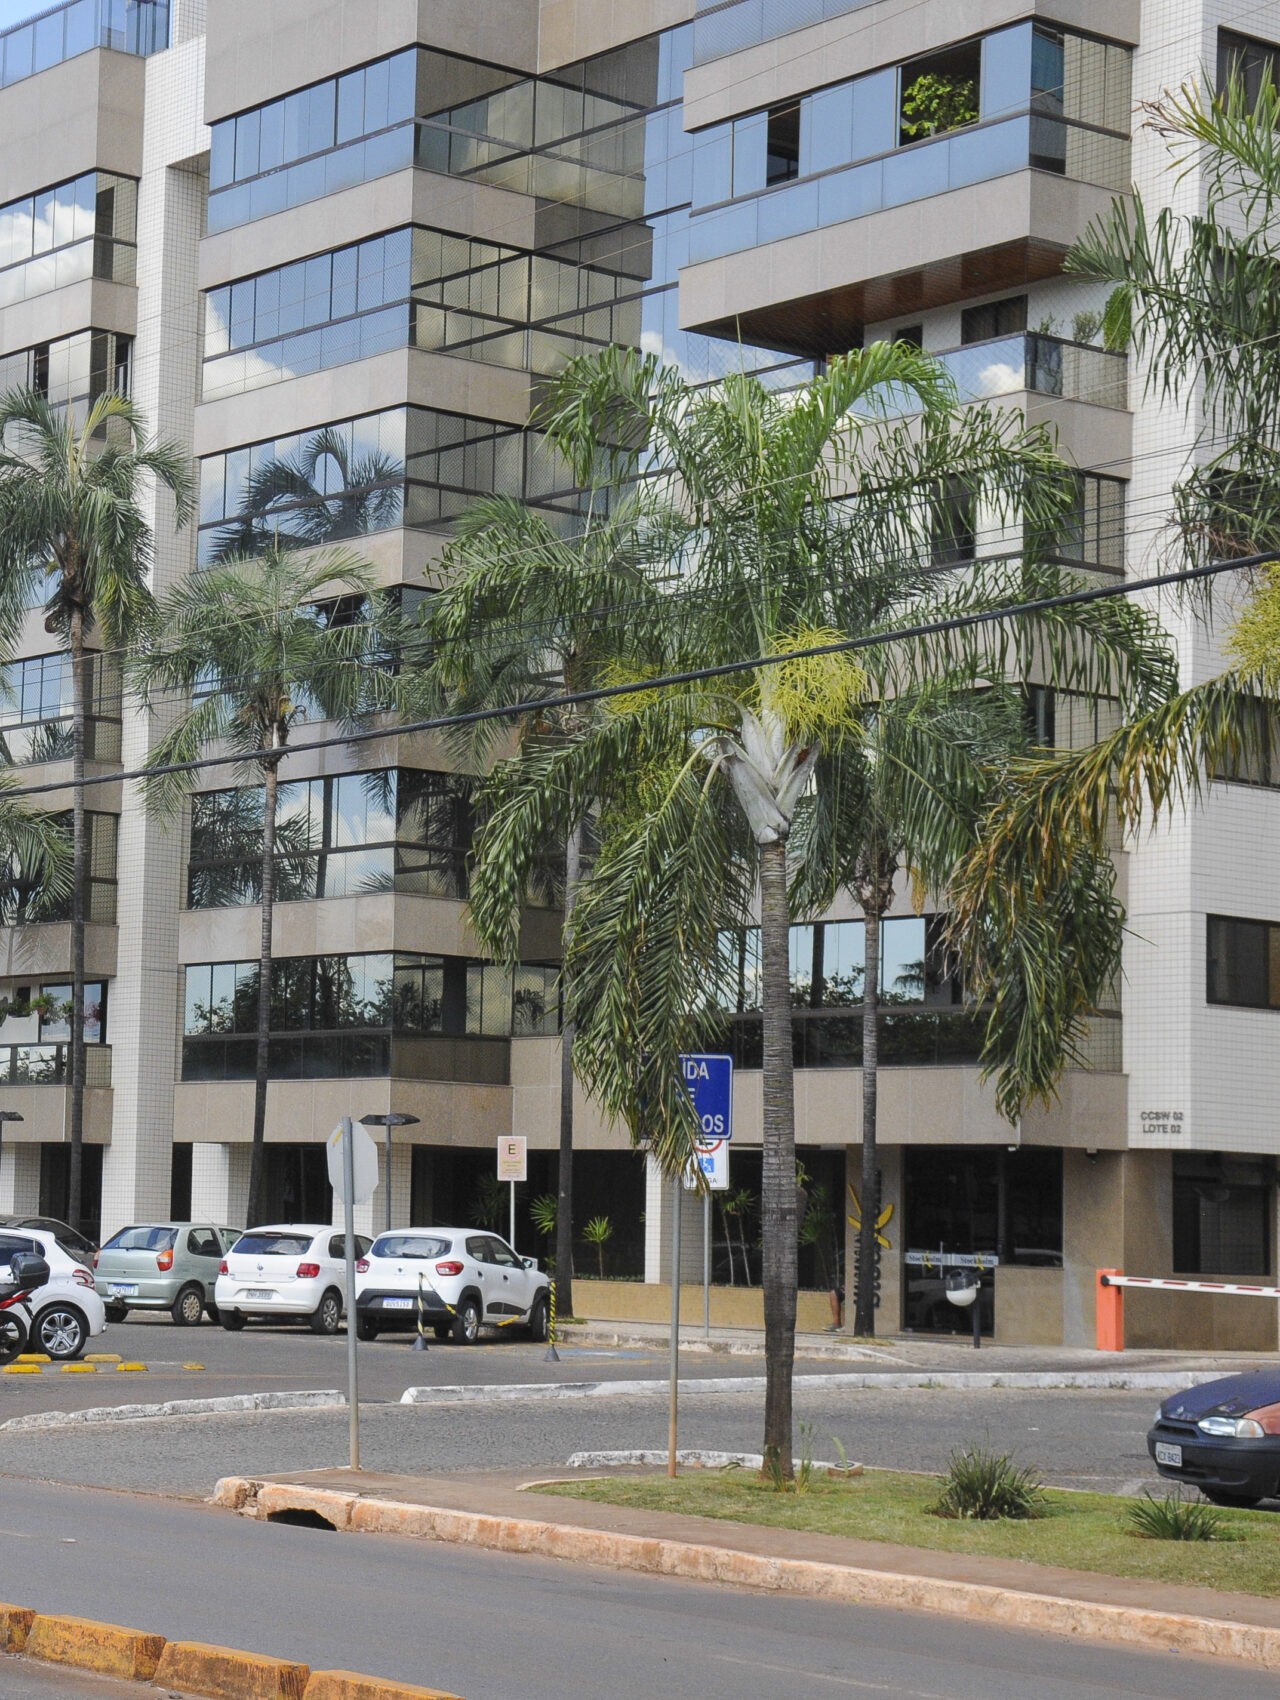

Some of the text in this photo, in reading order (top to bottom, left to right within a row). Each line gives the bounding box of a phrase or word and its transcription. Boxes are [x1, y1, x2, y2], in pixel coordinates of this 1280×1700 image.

[1143, 1124, 1181, 1134] LOTE 02
[508, 1143, 517, 1155] E
